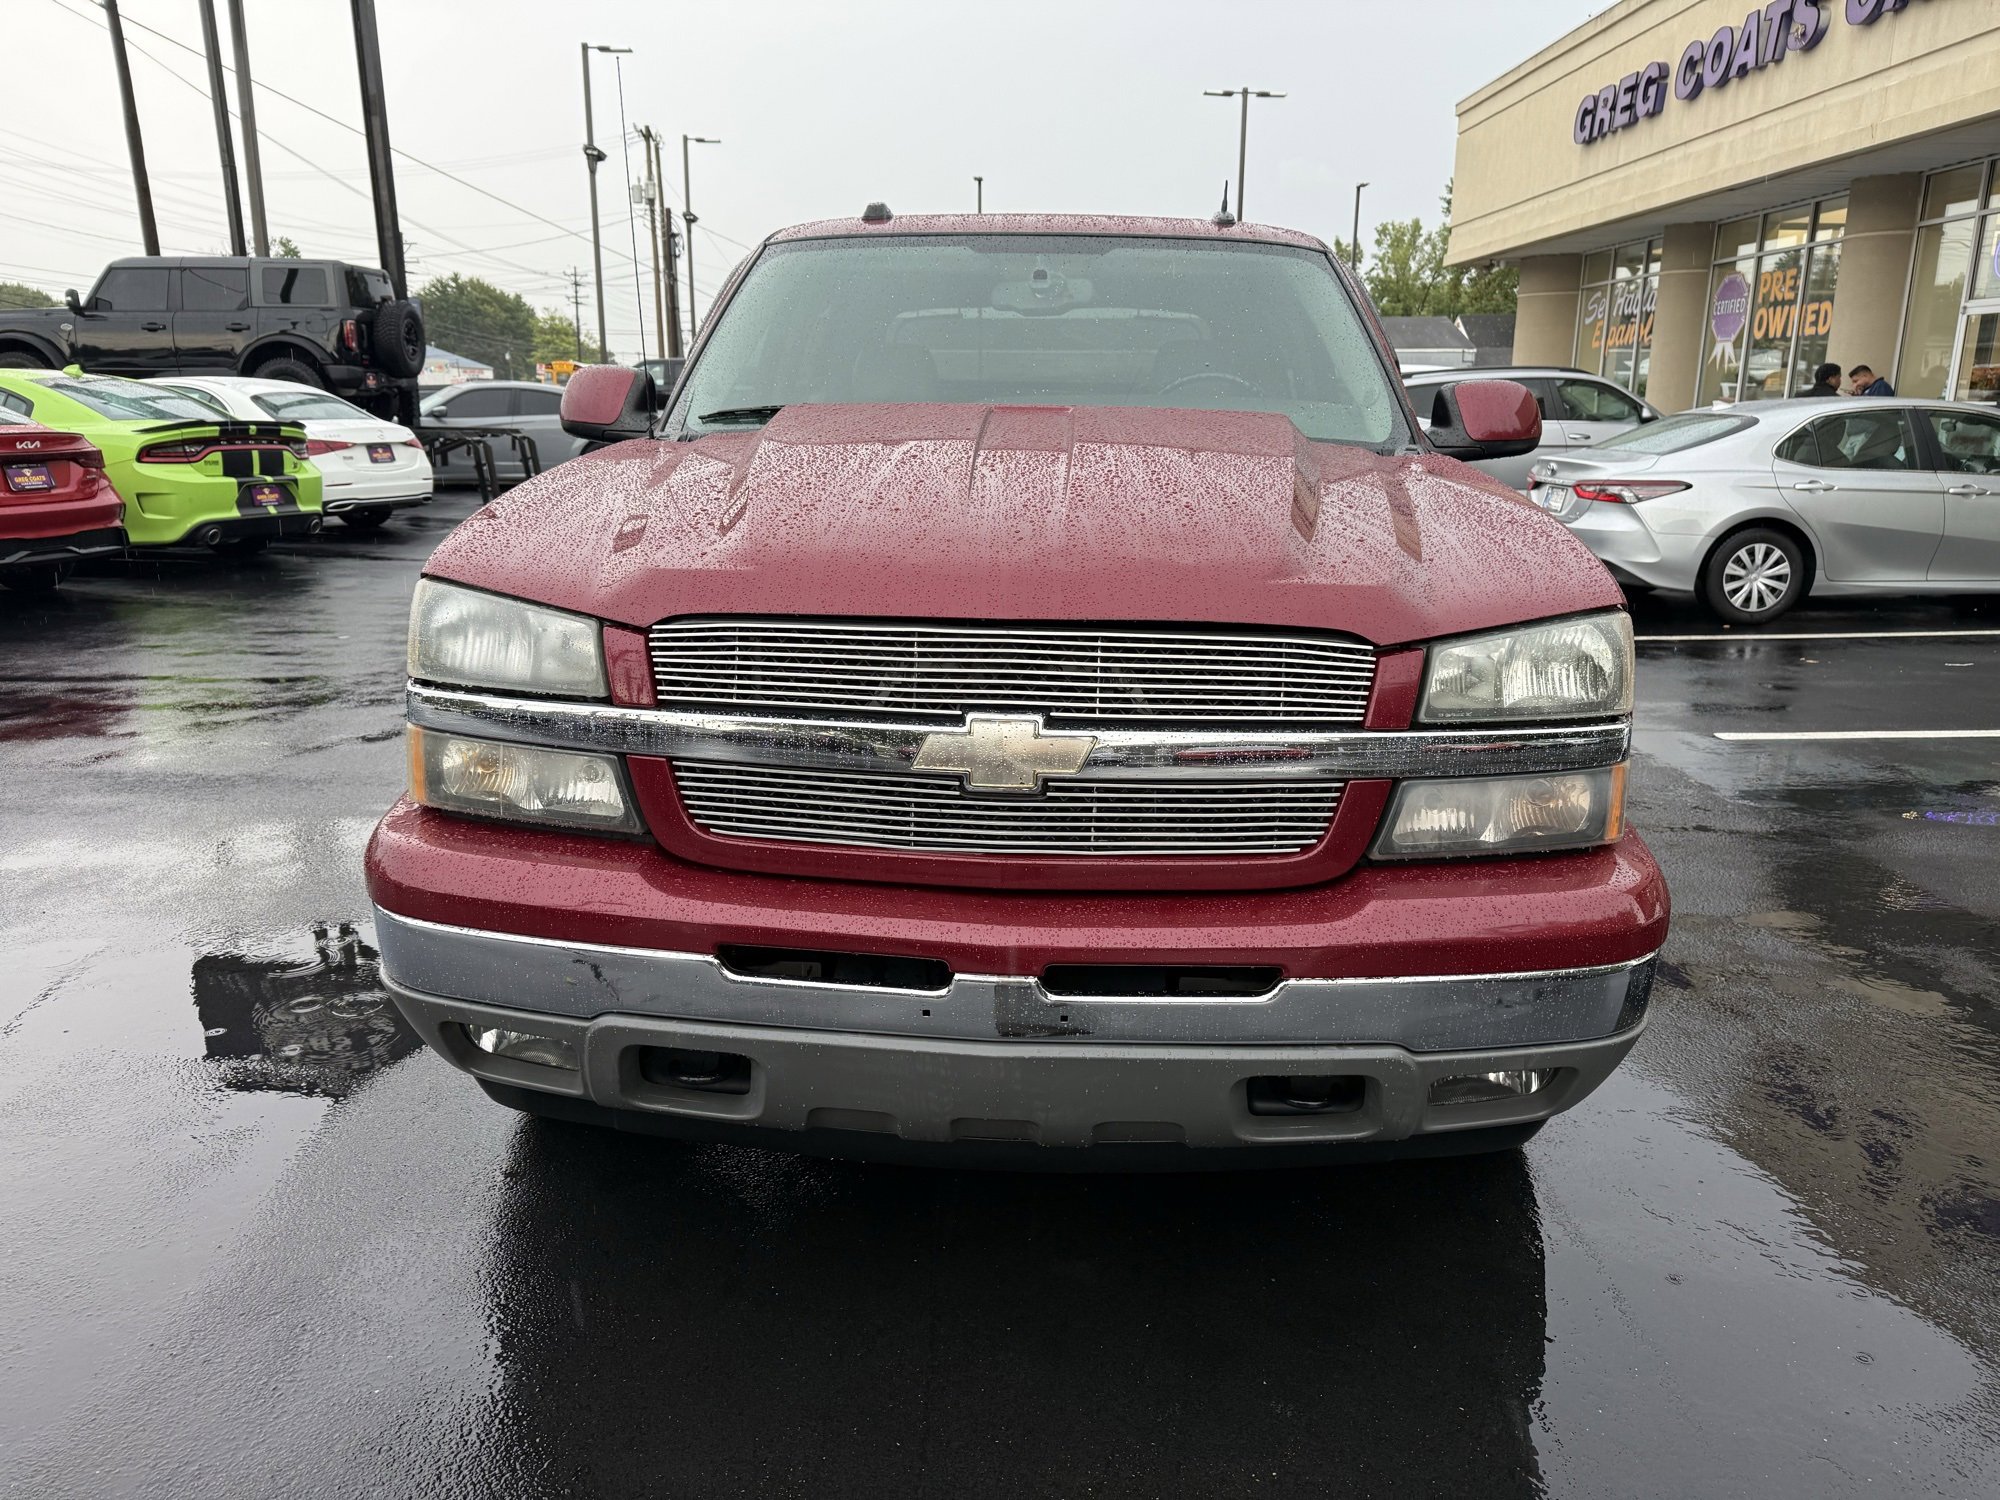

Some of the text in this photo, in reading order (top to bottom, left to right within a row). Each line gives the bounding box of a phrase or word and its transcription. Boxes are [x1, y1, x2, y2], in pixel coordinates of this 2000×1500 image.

[1574, 0, 1831, 145] GREG COATS
[1584, 290, 1606, 325] Se
[1713, 298, 1746, 316] CERTIFIED
[1753, 300, 1834, 340] OWNED
[15, 440, 41, 449] KIA
